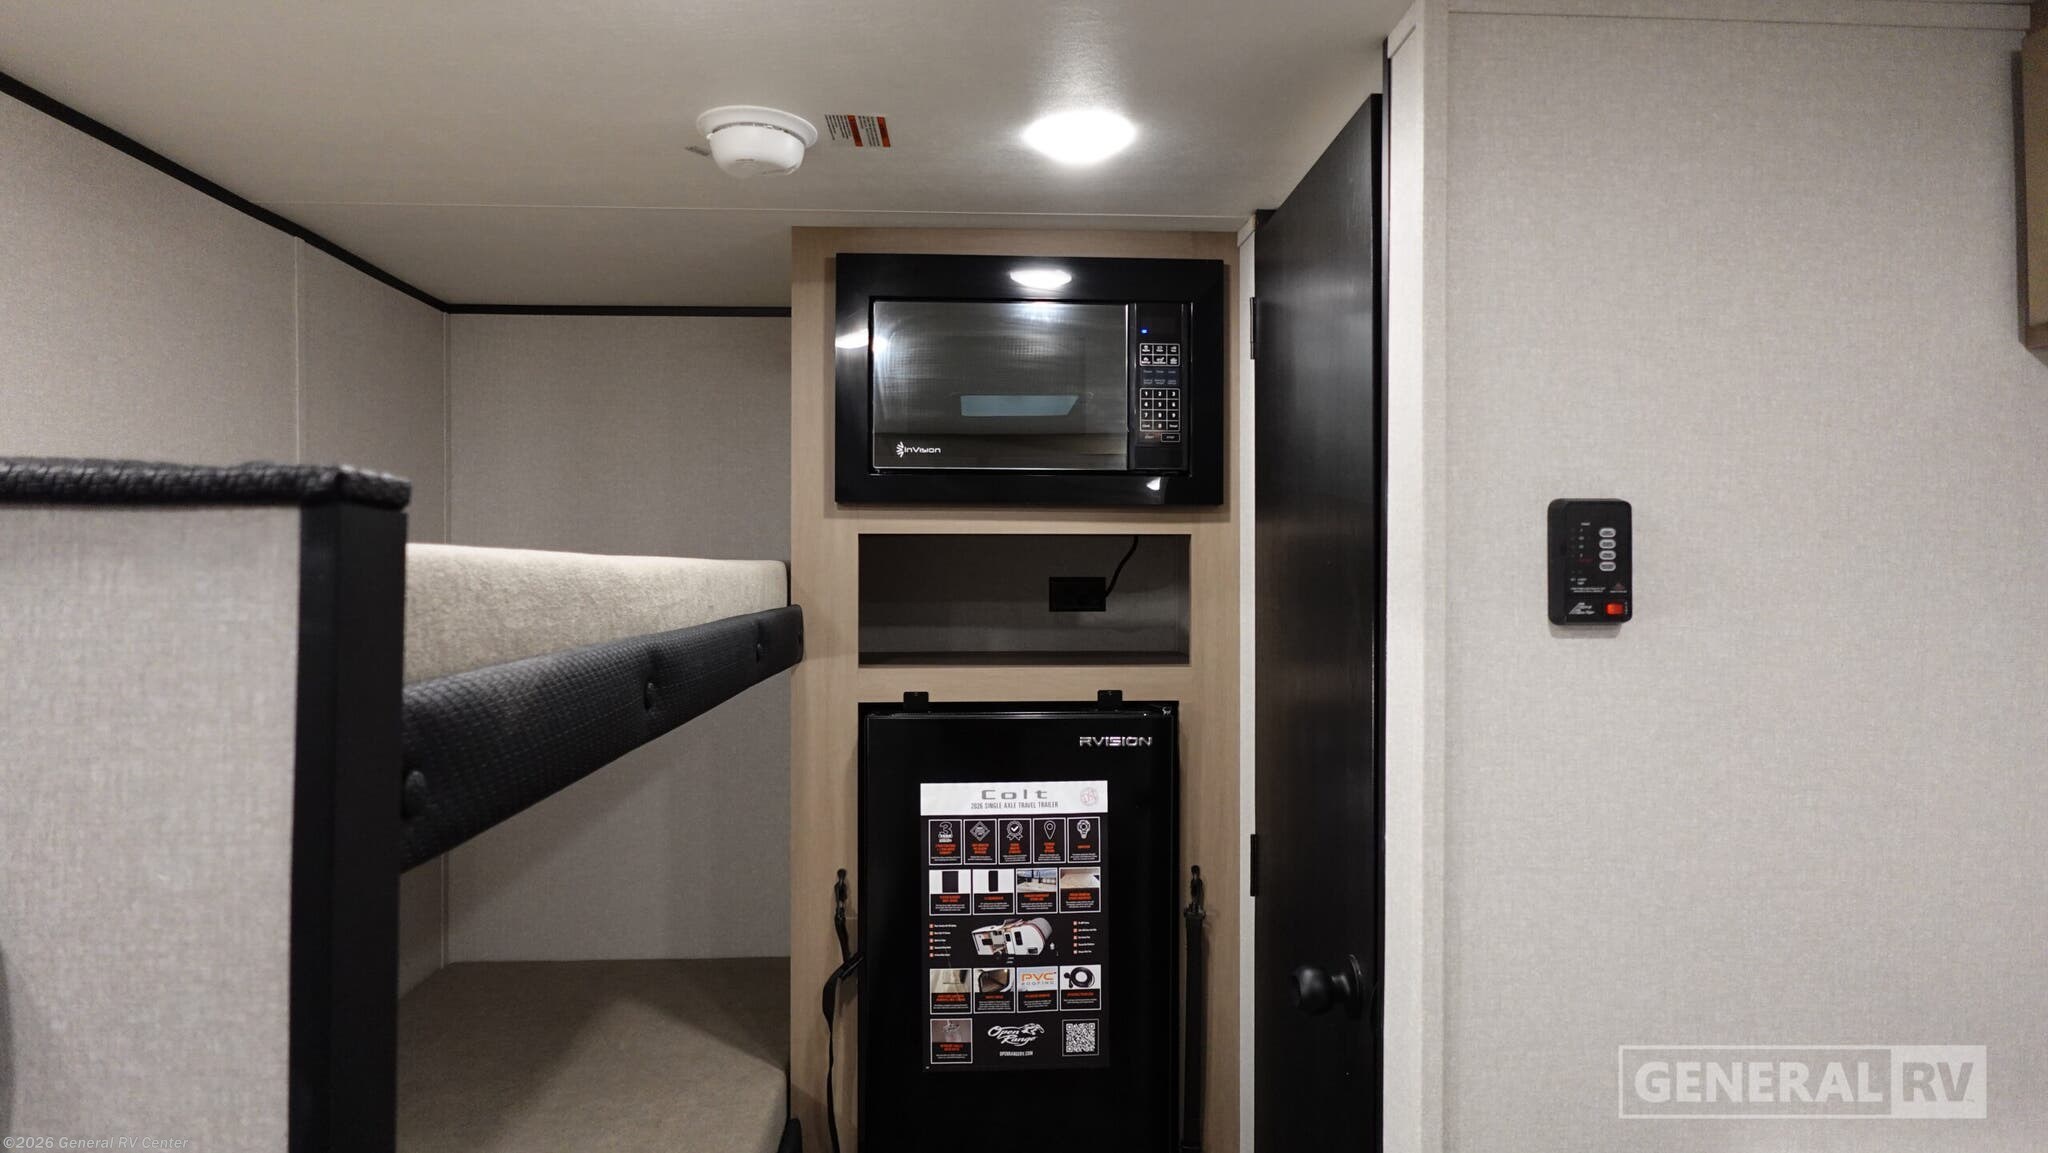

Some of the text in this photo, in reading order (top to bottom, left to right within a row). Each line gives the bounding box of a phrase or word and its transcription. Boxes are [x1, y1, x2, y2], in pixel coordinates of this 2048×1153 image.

[1079, 736, 1152, 747] RVISION
[981, 789, 1048, 800] Colt
[984, 802, 1002, 810] SINGLE
[1003, 801, 1017, 809] AXLE
[1018, 801, 1037, 809] TRAVEL
[1038, 801, 1059, 809] TRAILER
[1021, 972, 1055, 982] PVC
[988, 1025, 1020, 1040] Open
[1000, 1034, 1038, 1047] Range
